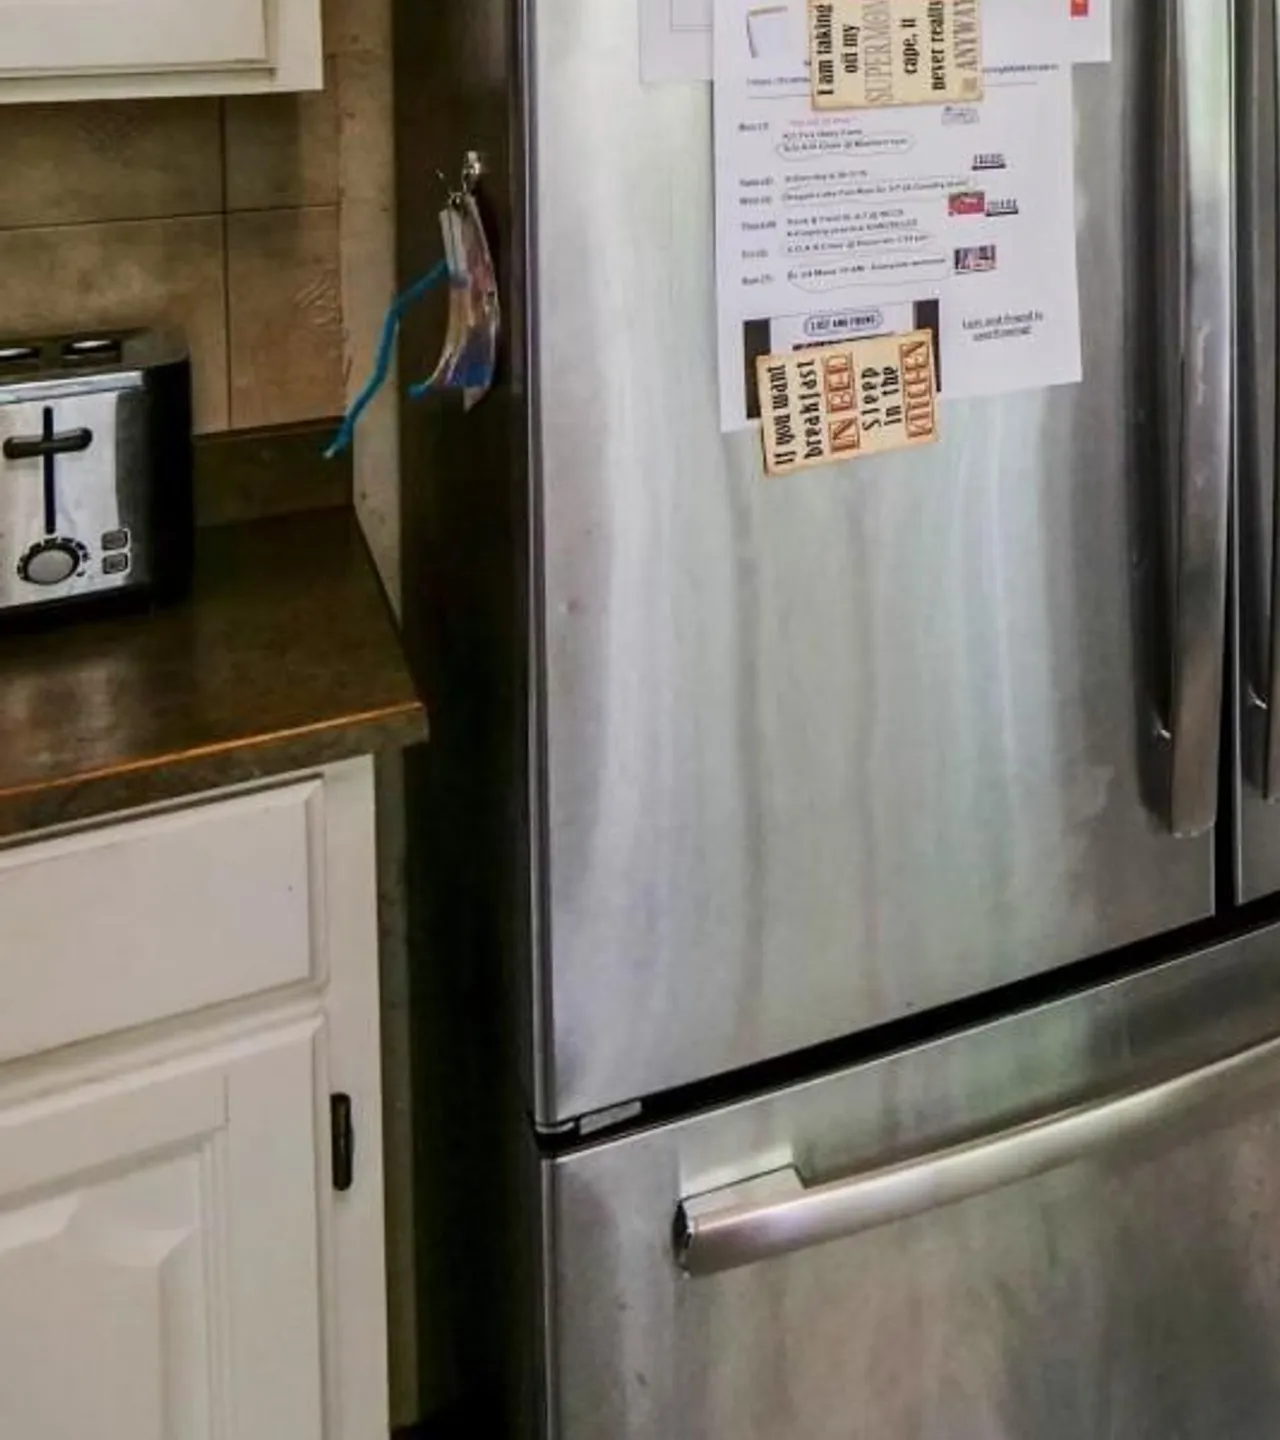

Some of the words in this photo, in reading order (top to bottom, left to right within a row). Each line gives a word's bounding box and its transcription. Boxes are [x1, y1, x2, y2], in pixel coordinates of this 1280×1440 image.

[814, 3, 833, 55] taking
[842, 24, 860, 47] my
[927, 0, 946, 43] really
[818, 60, 834, 84] am
[931, 49, 946, 91] never
[767, 364, 789, 410] want
[823, 354, 857, 413] BED
[861, 367, 881, 431] Sleep
[881, 366, 899, 396] the
[901, 341, 933, 438] KITCHEN
[773, 413, 796, 446] you
[797, 359, 824, 460] breakfast
[884, 405, 902, 426] in
